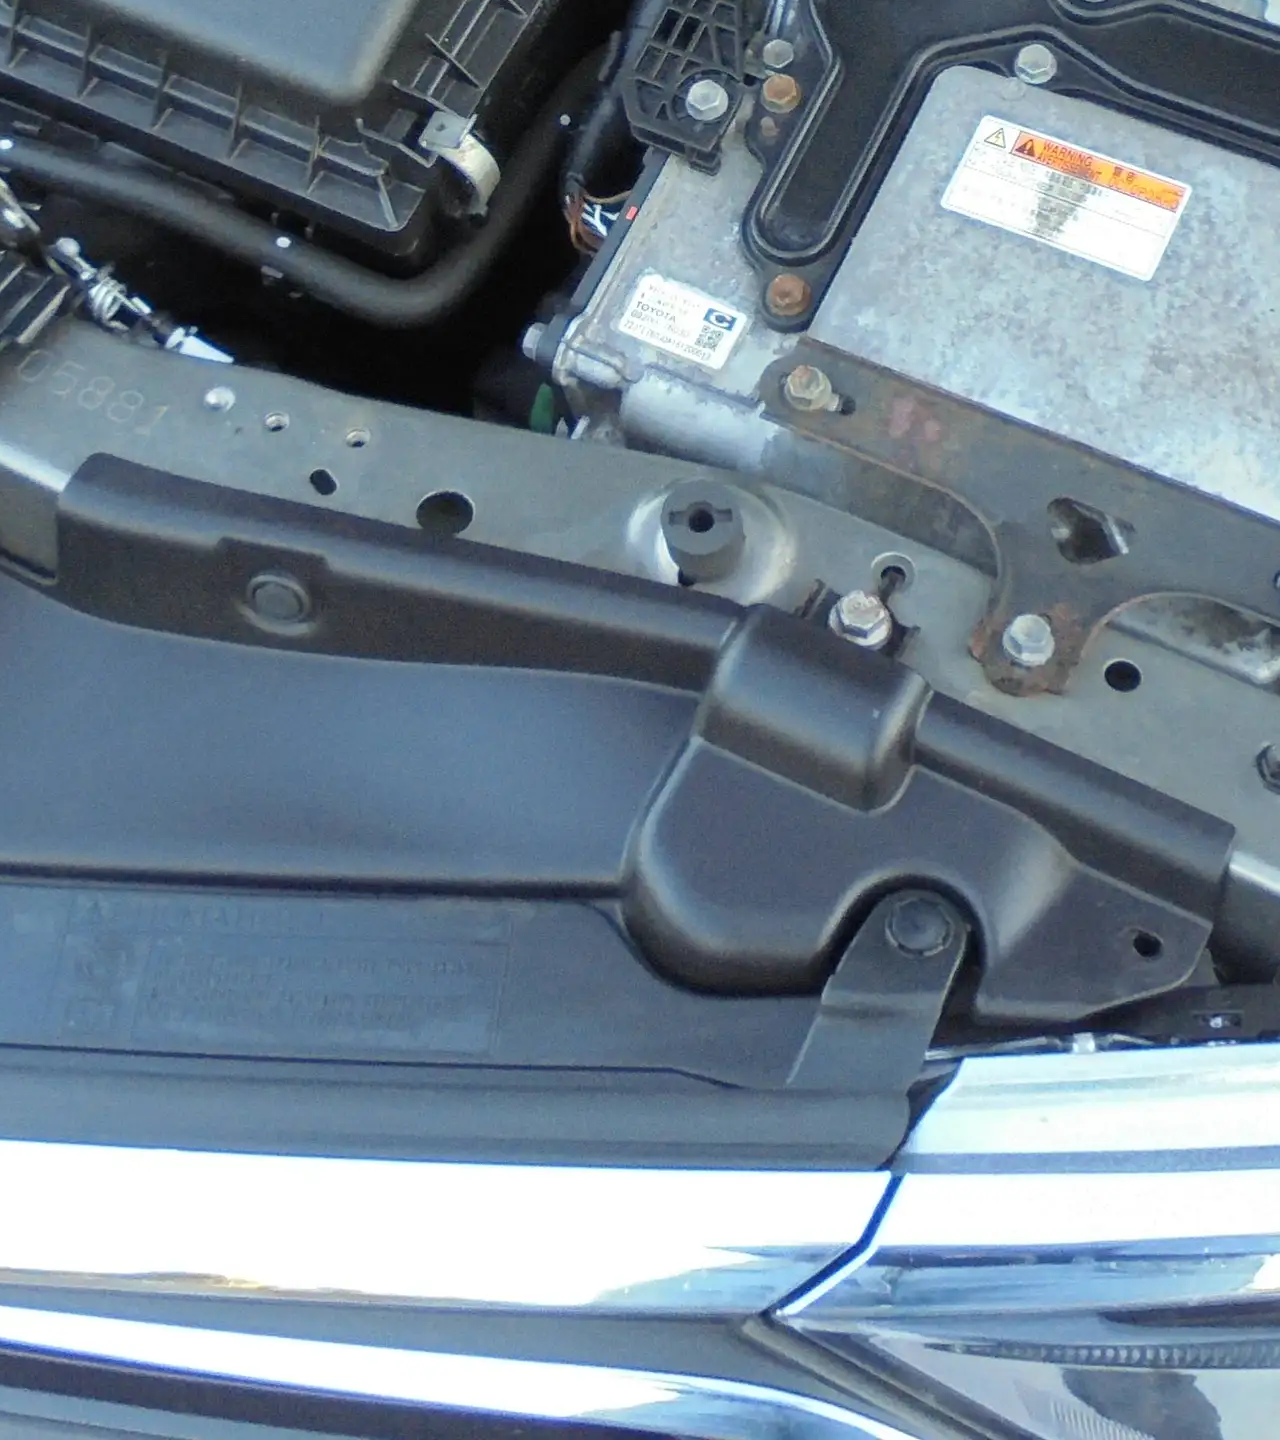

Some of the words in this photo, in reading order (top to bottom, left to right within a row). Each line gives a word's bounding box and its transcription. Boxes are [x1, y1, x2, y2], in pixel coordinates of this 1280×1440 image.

[1043, 140, 1092, 167] WARNING
[1036, 156, 1102, 182] AVERTISSENT
[637, 301, 676, 323] TOYOTA
